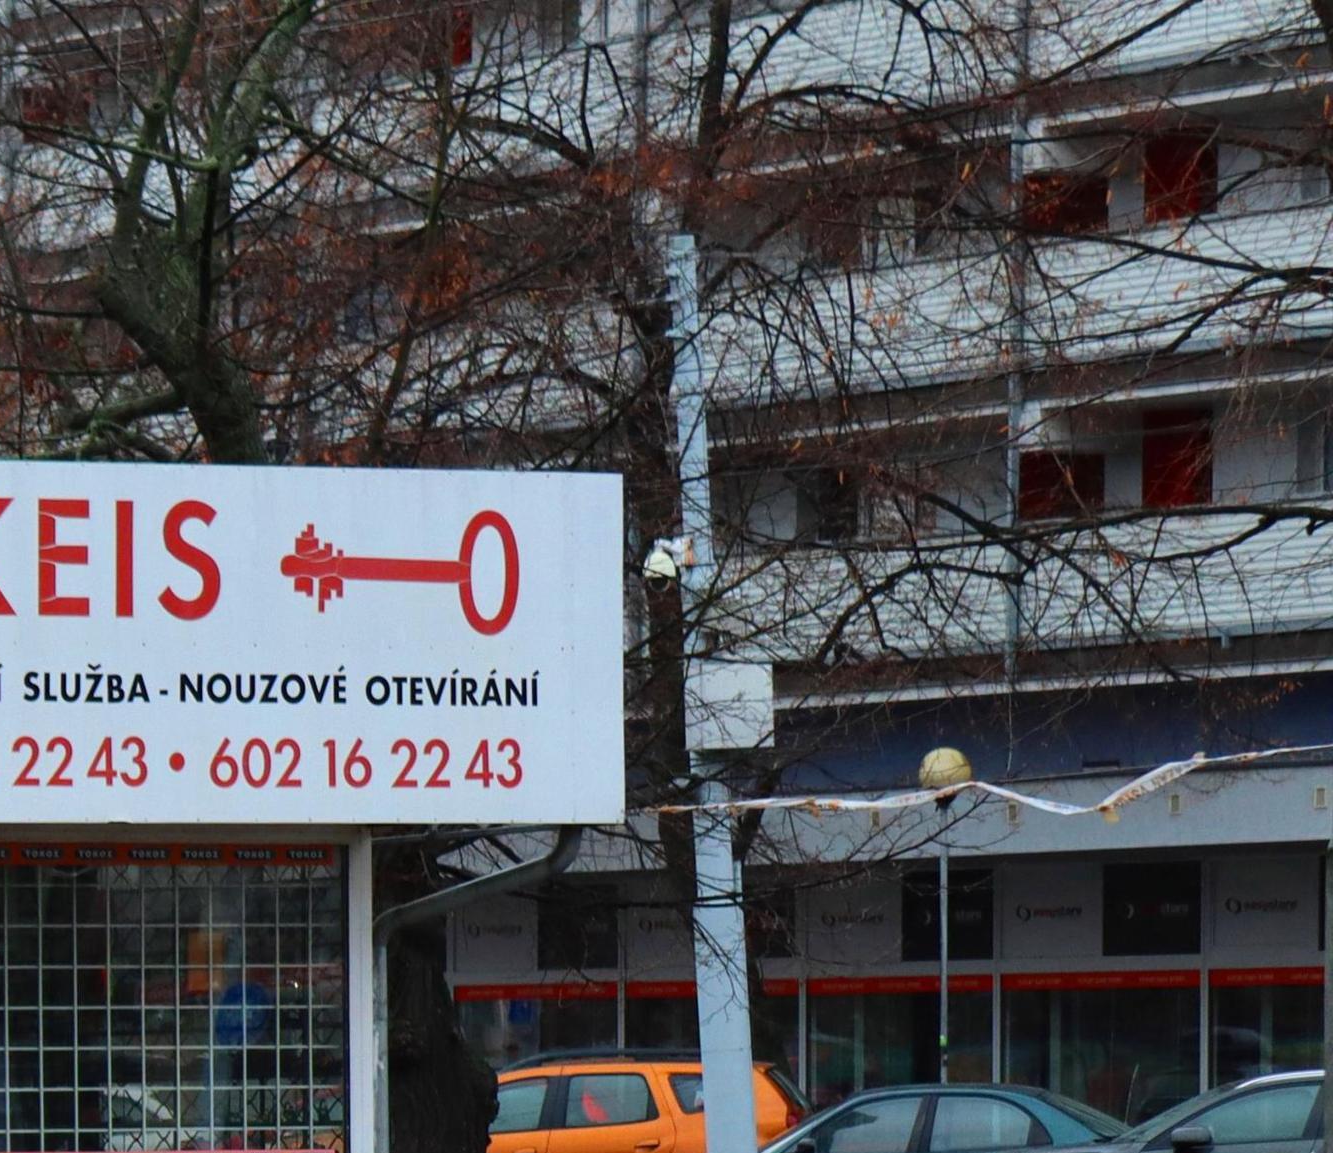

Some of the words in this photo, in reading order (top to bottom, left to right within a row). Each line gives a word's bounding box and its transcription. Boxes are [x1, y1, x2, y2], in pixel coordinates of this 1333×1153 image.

[23, 663, 151, 704] SLUŽBA
[179, 664, 347, 705] NOUZOVÉ
[365, 668, 540, 707] OTEVÍRÁNÍ
[11, 735, 74, 788] 22
[86, 735, 149, 788] 43
[209, 737, 303, 789] 602
[322, 737, 373, 789] 16
[390, 738, 451, 789] 22
[464, 737, 524, 790] 43
